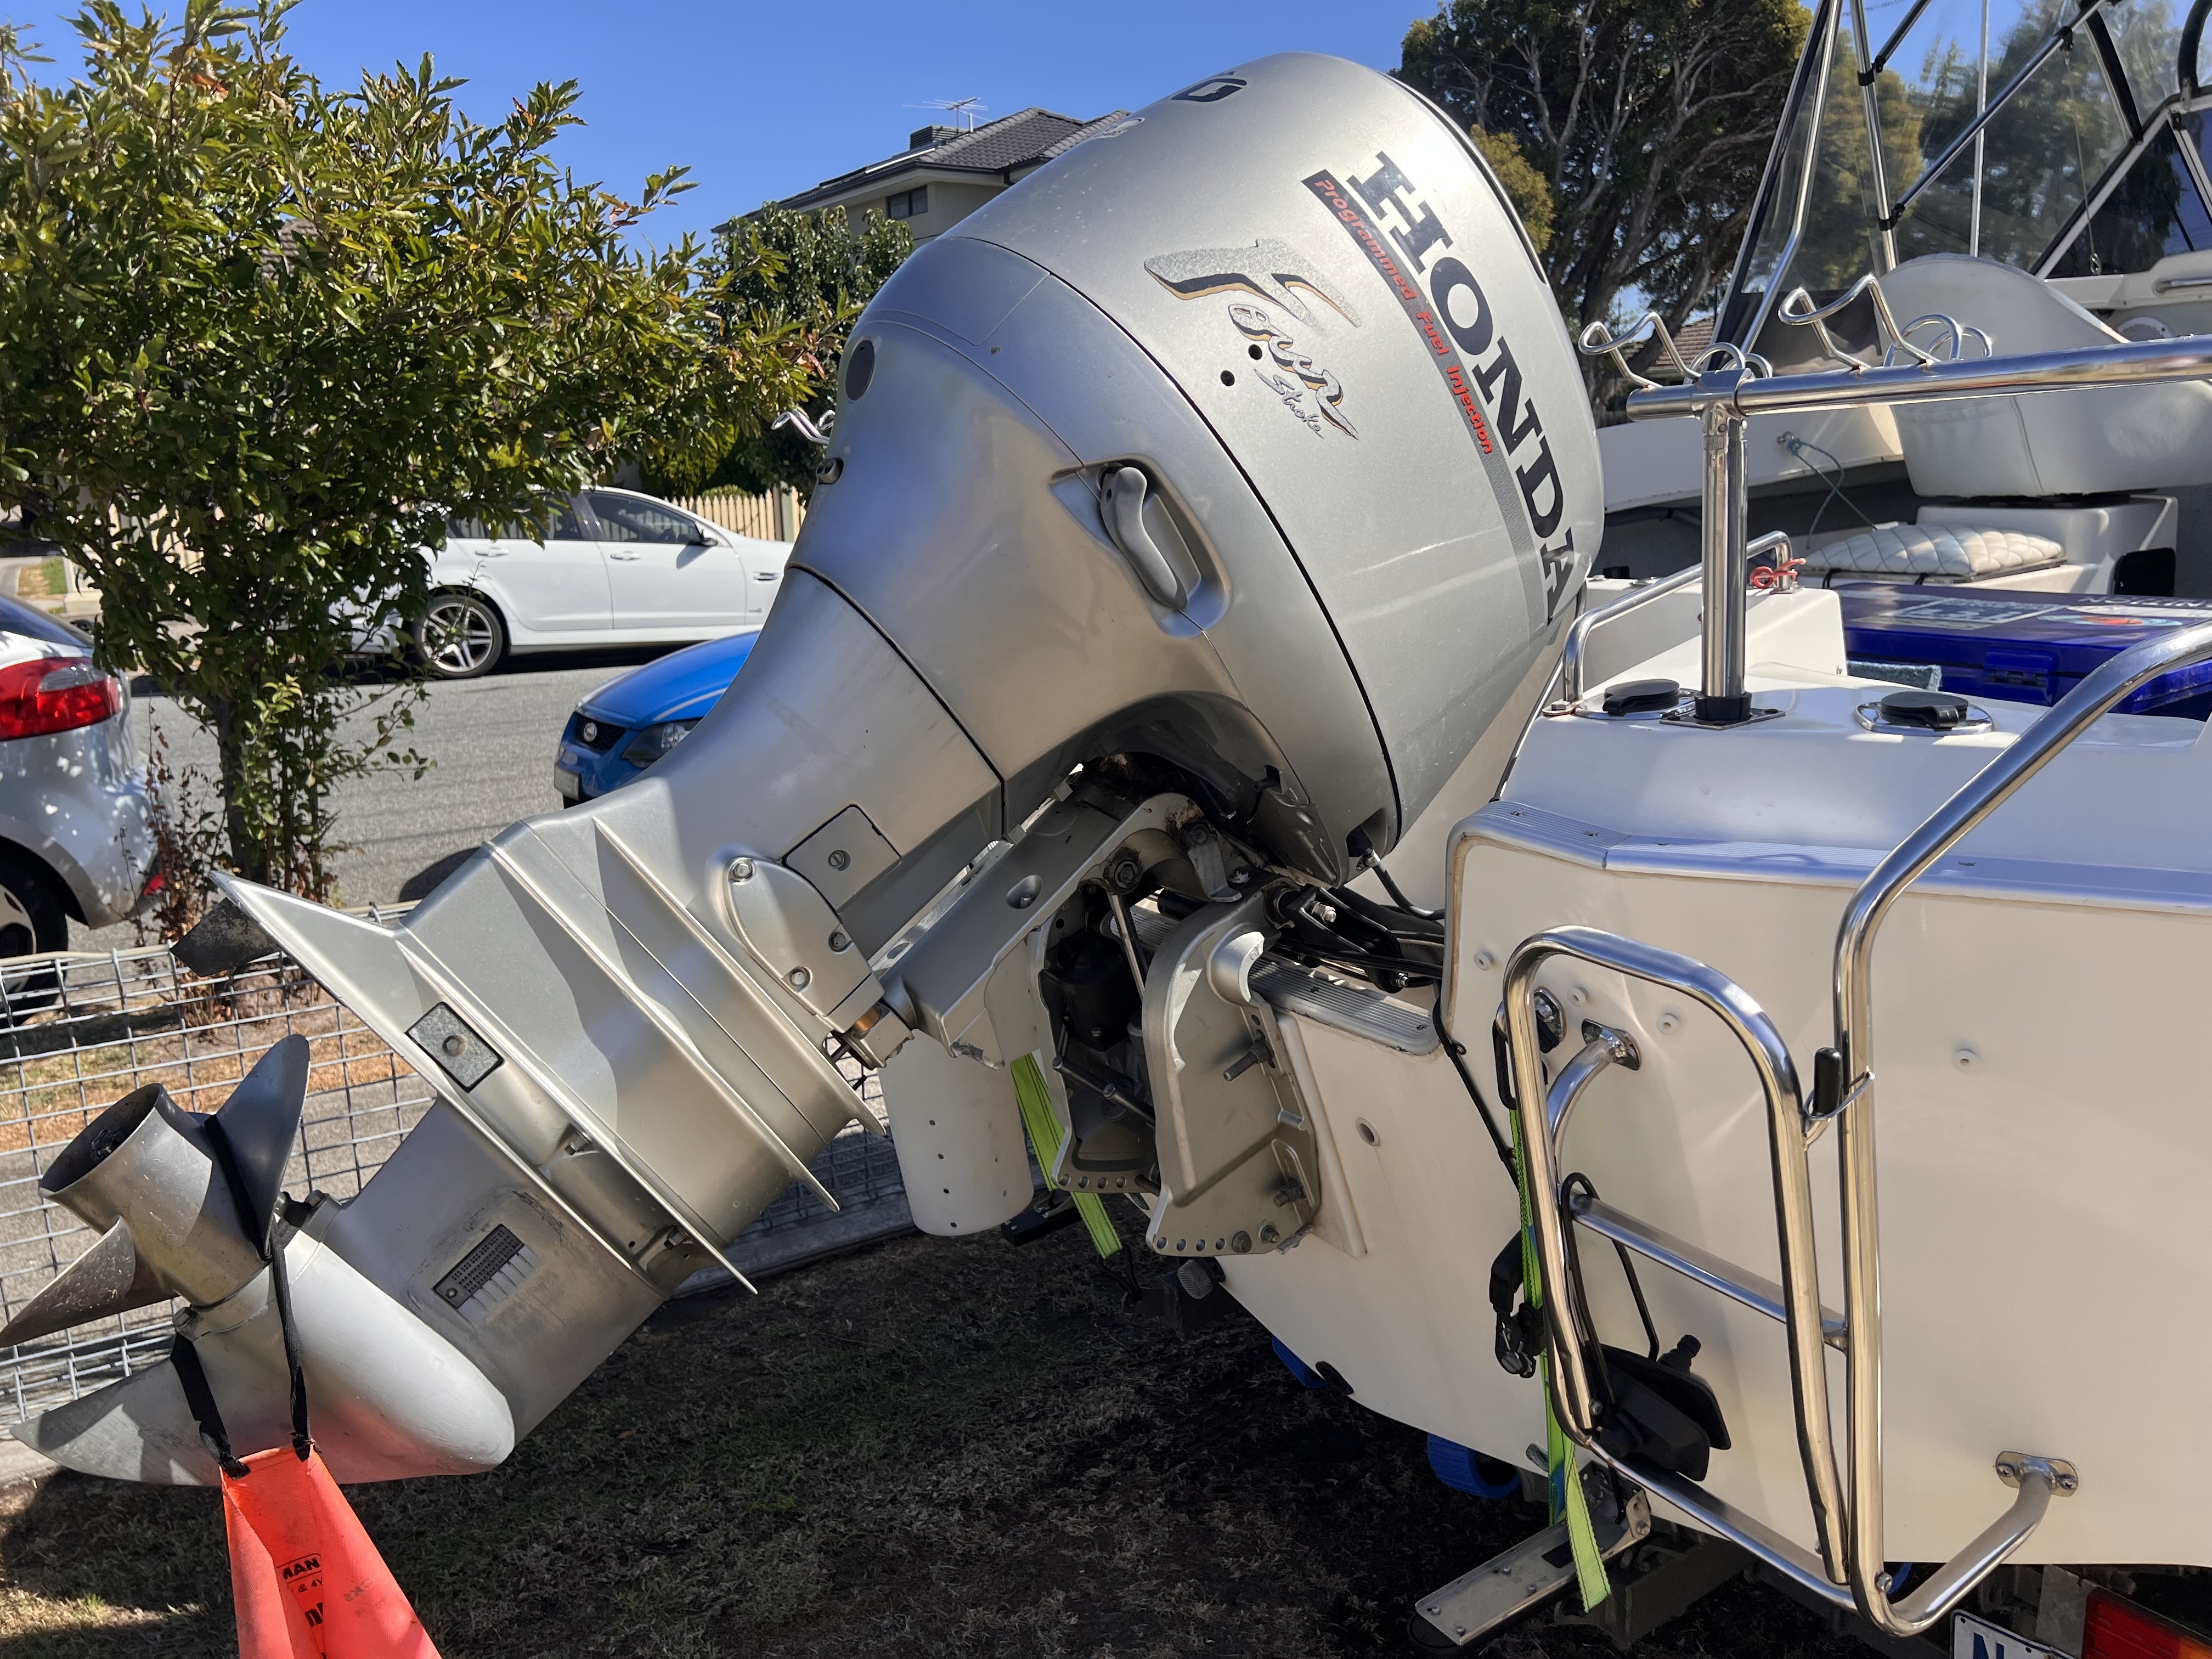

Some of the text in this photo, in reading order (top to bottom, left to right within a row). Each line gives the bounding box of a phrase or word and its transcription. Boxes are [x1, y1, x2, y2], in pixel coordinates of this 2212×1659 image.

[1254, 369, 1324, 439] Stroke
[1314, 179, 1493, 454] Programmed Fuel Injection
[1347, 150, 1576, 626] HONDA
